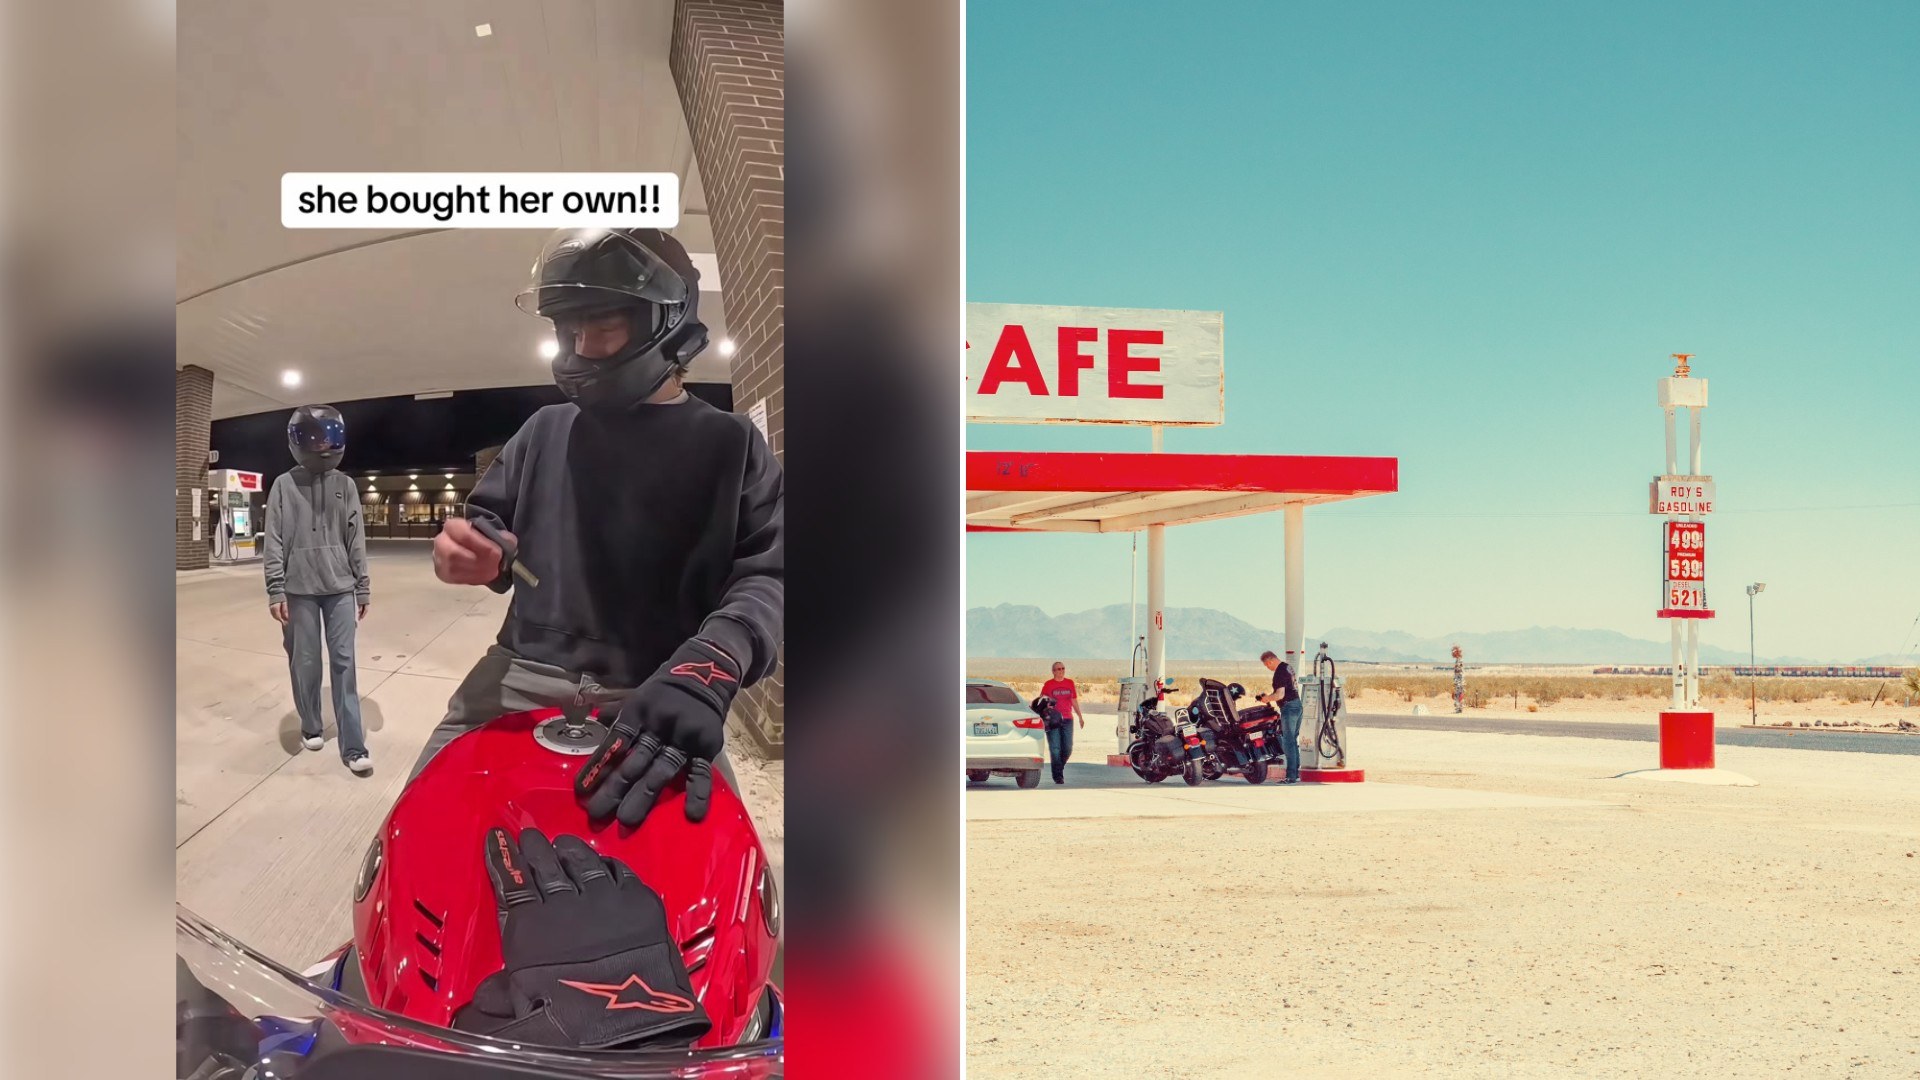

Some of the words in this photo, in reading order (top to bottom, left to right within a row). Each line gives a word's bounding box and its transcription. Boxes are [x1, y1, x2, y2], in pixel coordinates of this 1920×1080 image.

[966, 324, 1164, 400] AFE
[1670, 486, 1703, 498] ROY'S
[1658, 501, 1713, 512] GASOLINE
